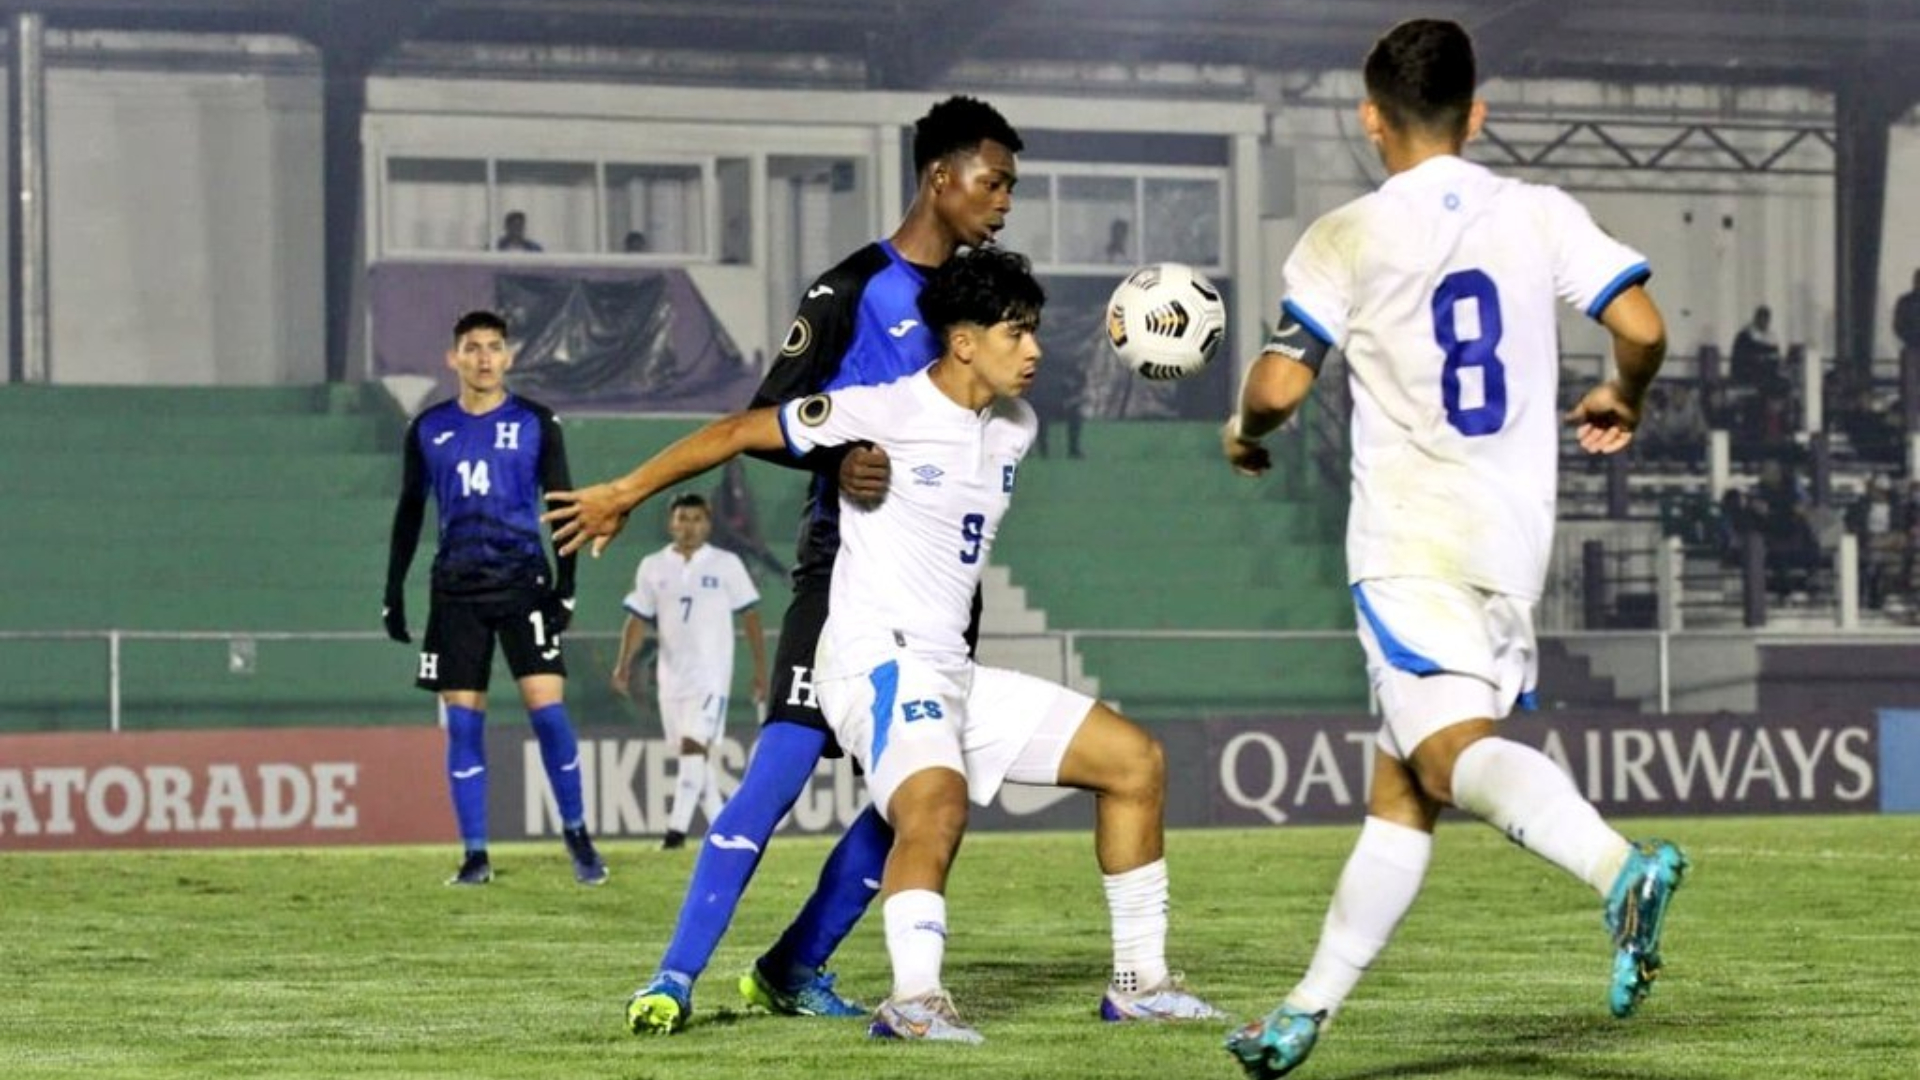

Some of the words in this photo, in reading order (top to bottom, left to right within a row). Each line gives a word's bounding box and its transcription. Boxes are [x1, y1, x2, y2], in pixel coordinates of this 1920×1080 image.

[1431, 268, 1507, 437] 8
[494, 422, 520, 449] H
[457, 460, 490, 496] 14
[1002, 464, 1018, 493] E
[960, 513, 985, 564] 9
[680, 597, 692, 623] 7
[418, 653, 439, 679] H
[786, 665, 819, 709] H
[901, 700, 943, 723] ES
[1220, 730, 1378, 824] QAT
